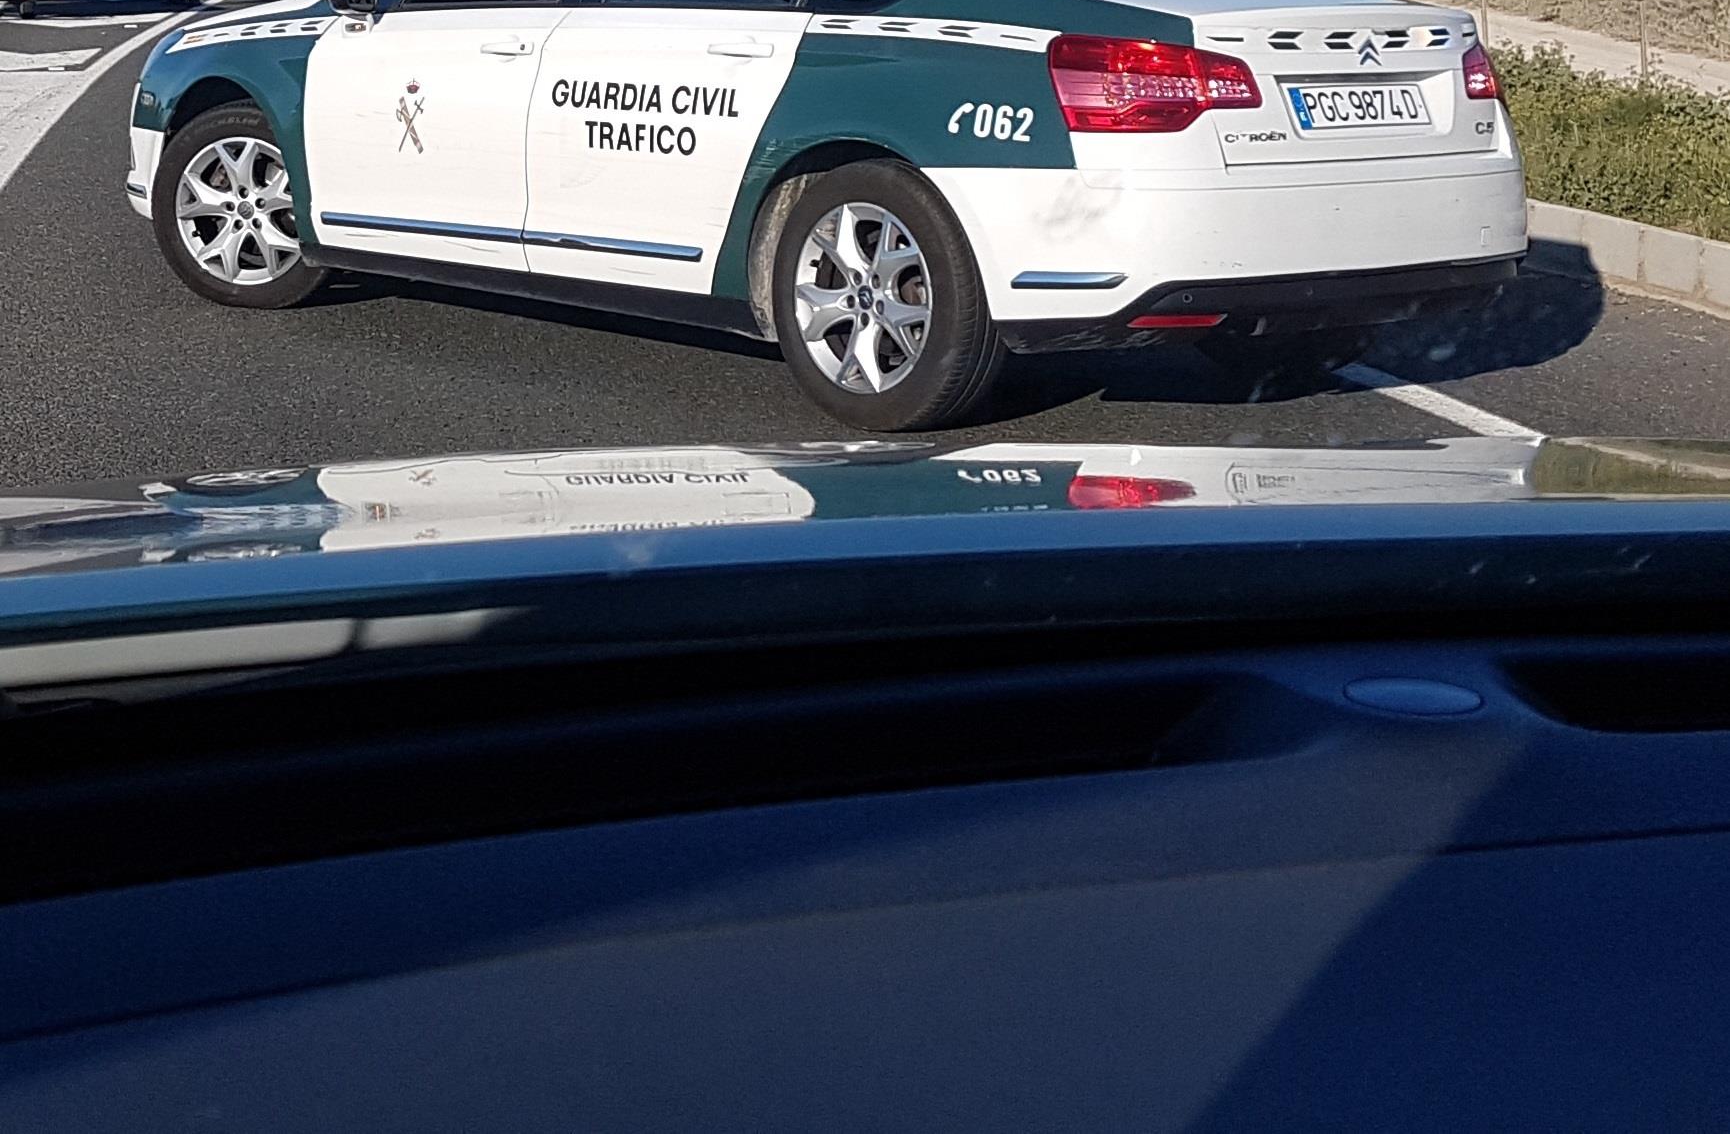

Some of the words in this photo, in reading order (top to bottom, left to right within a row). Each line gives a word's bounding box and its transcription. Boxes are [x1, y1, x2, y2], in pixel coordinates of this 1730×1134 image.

[552, 78, 661, 113] GUARDIA
[672, 85, 739, 117] CIVIL
[585, 120, 697, 155] TRAFICO
[973, 103, 1034, 142] 062
[1475, 121, 1495, 135] C5
